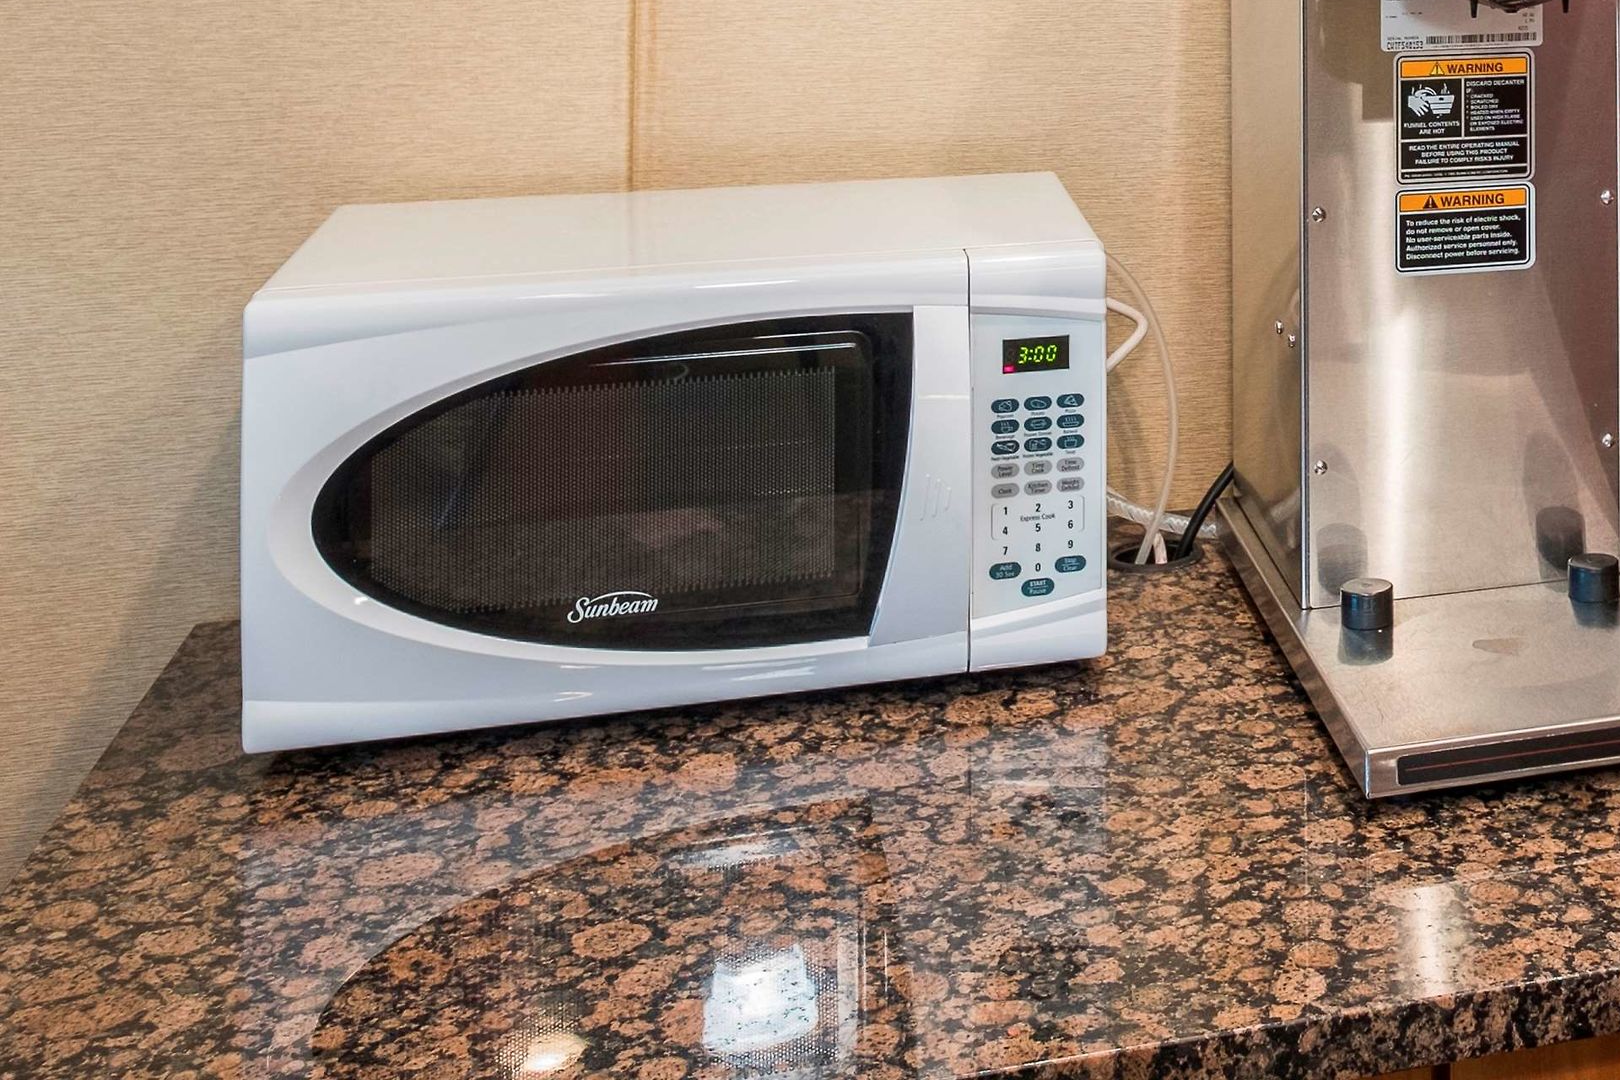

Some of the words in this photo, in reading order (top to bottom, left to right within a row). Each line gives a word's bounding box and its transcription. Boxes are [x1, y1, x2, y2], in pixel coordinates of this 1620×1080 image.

[1447, 62, 1504, 74] WARNING
[1440, 193, 1505, 207] WARNING
[1468, 240, 1501, 248] personnel
[1406, 252, 1443, 260] Disconnect
[1444, 251, 1465, 259] power
[1018, 344, 1058, 364] 3:00
[1035, 503, 1041, 513] 2
[1067, 500, 1074, 510] 3
[1003, 506, 1008, 515] 1
[1035, 523, 1041, 532] 5
[1067, 520, 1074, 529] 6
[1002, 526, 1008, 535] 4
[1035, 543, 1041, 552] 8
[1067, 539, 1074, 549] 9
[1002, 546, 1008, 556] 7
[1035, 563, 1041, 572] 0
[567, 594, 659, 623] Sunbeam
